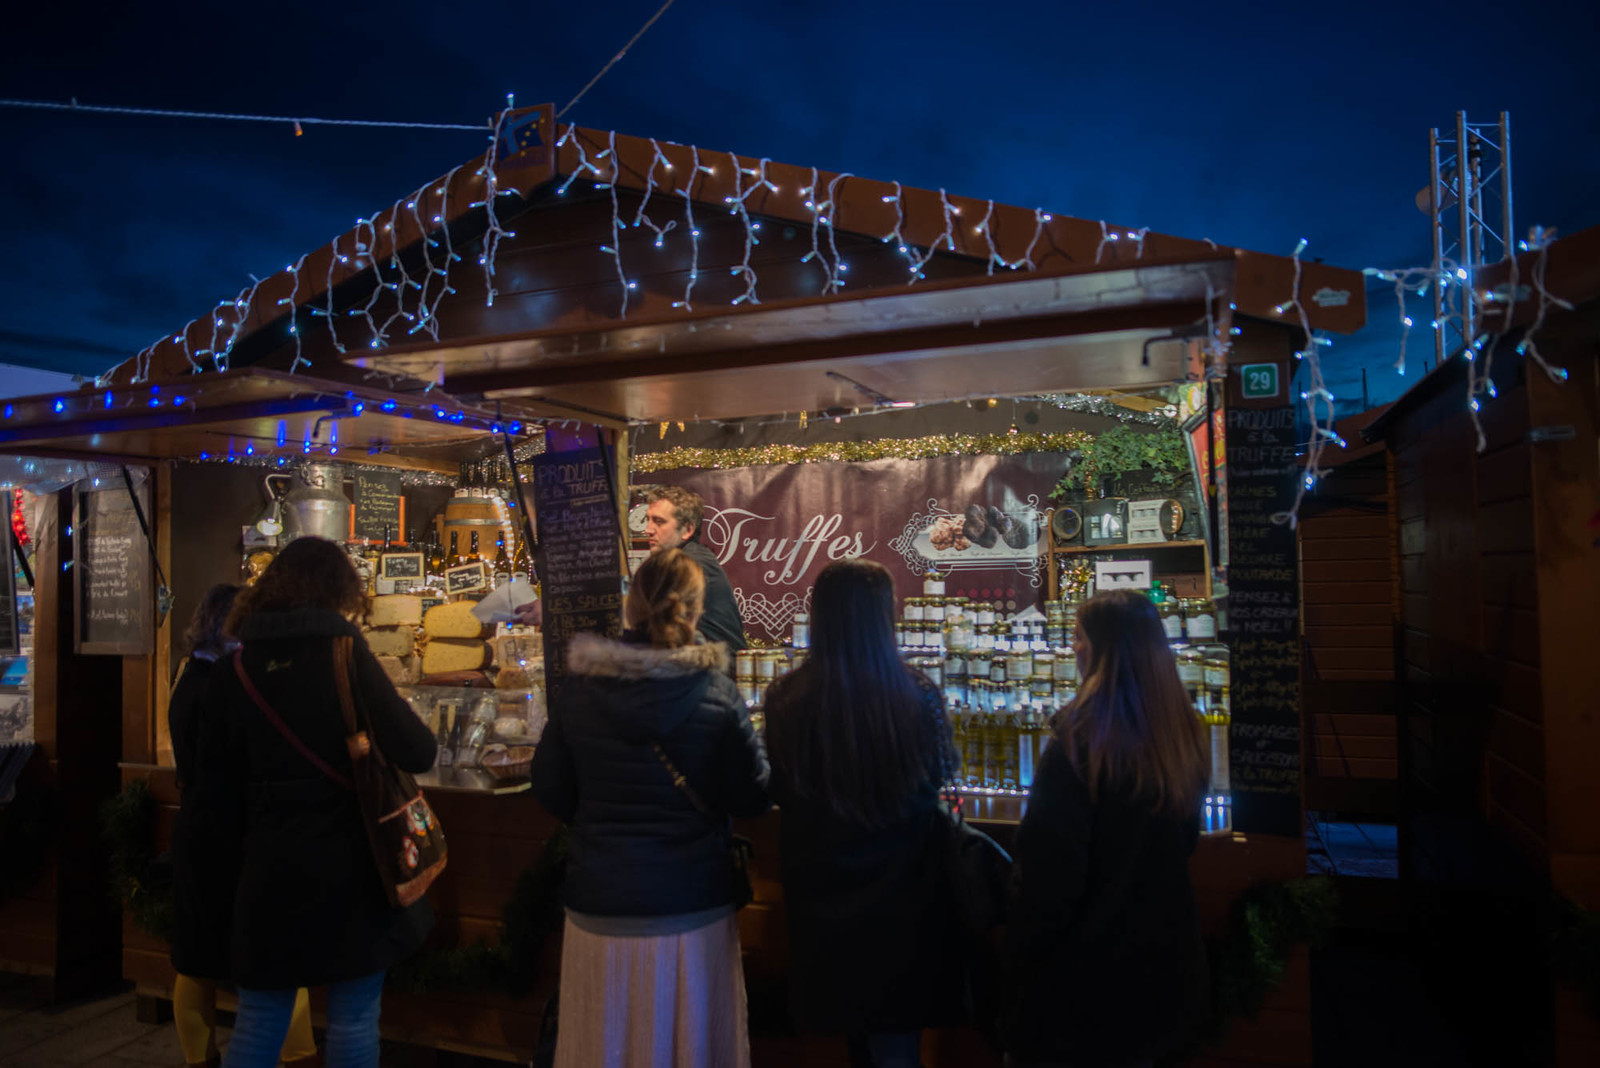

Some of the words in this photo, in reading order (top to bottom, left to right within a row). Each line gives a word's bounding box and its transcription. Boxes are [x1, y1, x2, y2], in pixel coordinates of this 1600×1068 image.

[1249, 371, 1272, 391] 29
[1228, 409, 1294, 430] PRODUITS
[1228, 446, 1293, 463] TRUFFE
[703, 504, 878, 585] Truffes
[548, 595, 573, 612] LES
[577, 591, 622, 610] SAUCES
[1230, 590, 1281, 604] PENSEZ
